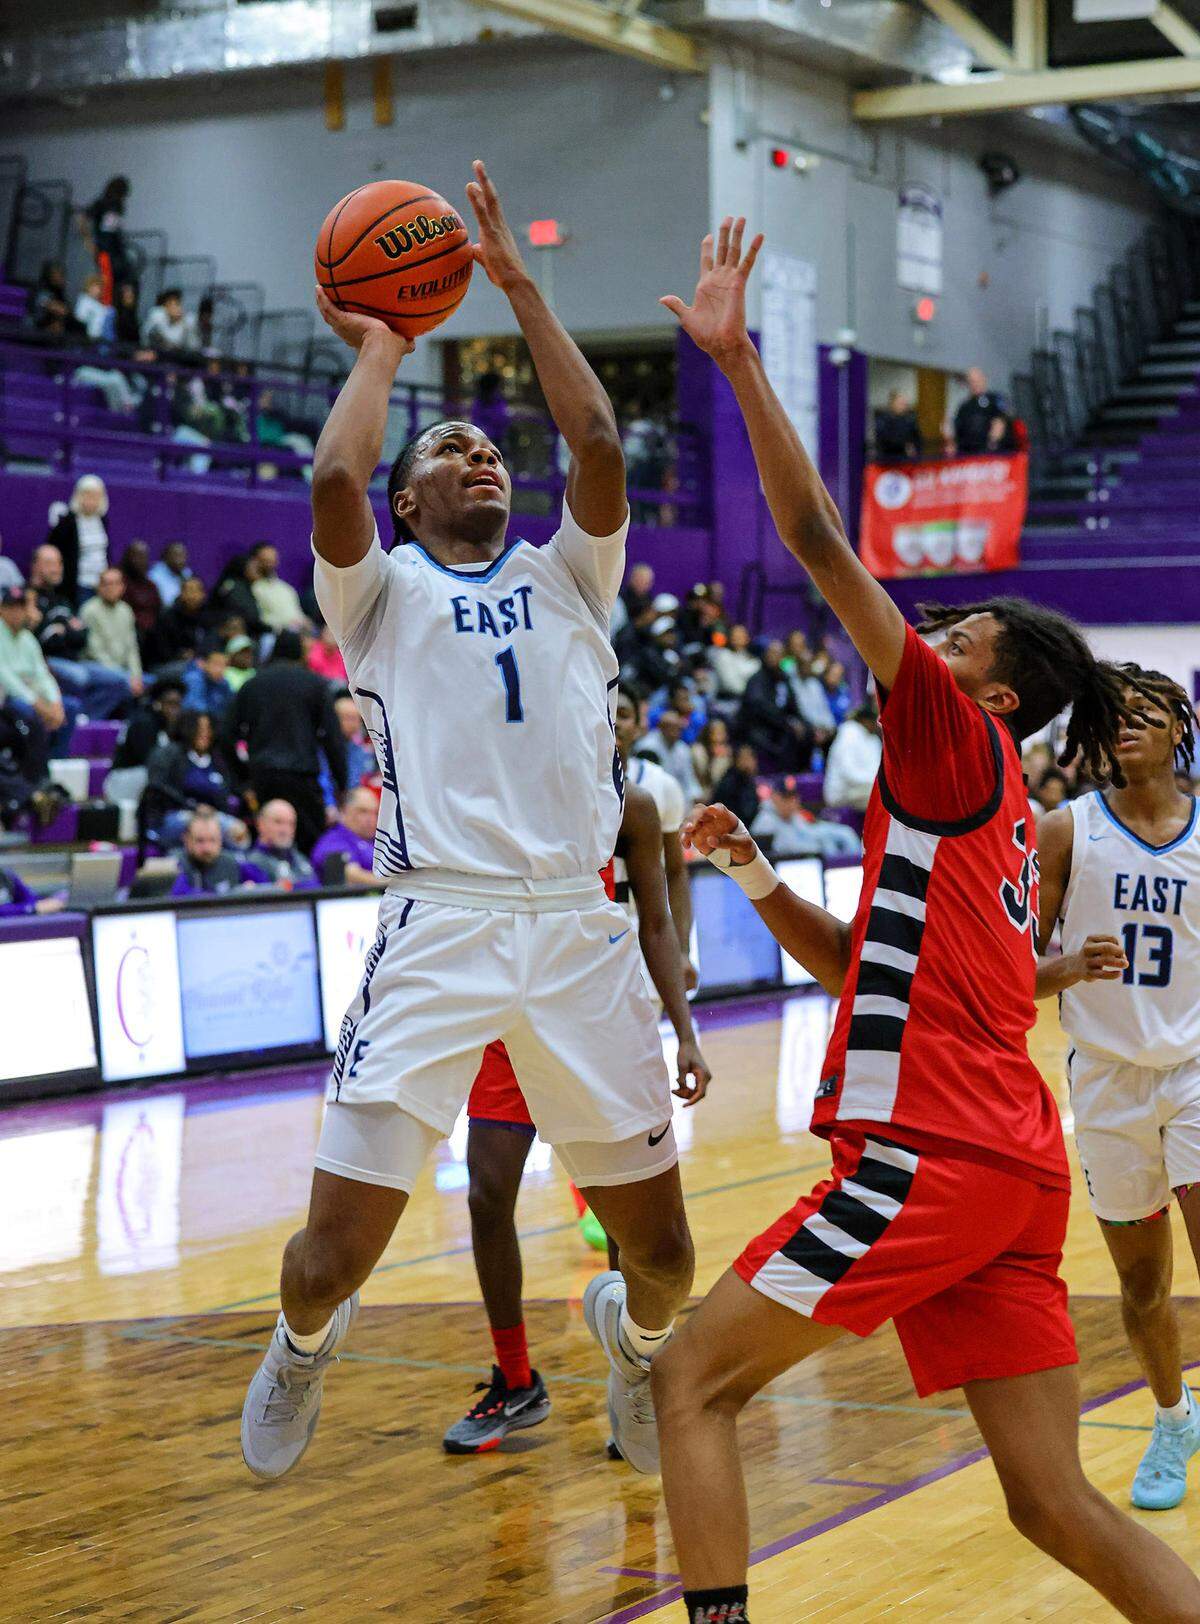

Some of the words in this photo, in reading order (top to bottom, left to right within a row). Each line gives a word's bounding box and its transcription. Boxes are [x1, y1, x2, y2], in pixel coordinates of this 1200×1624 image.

[373, 213, 464, 260] Wilson
[450, 585, 534, 638] EAST
[495, 645, 525, 723] 1
[1114, 873, 1188, 915] EAST
[1121, 923, 1173, 987] 13
